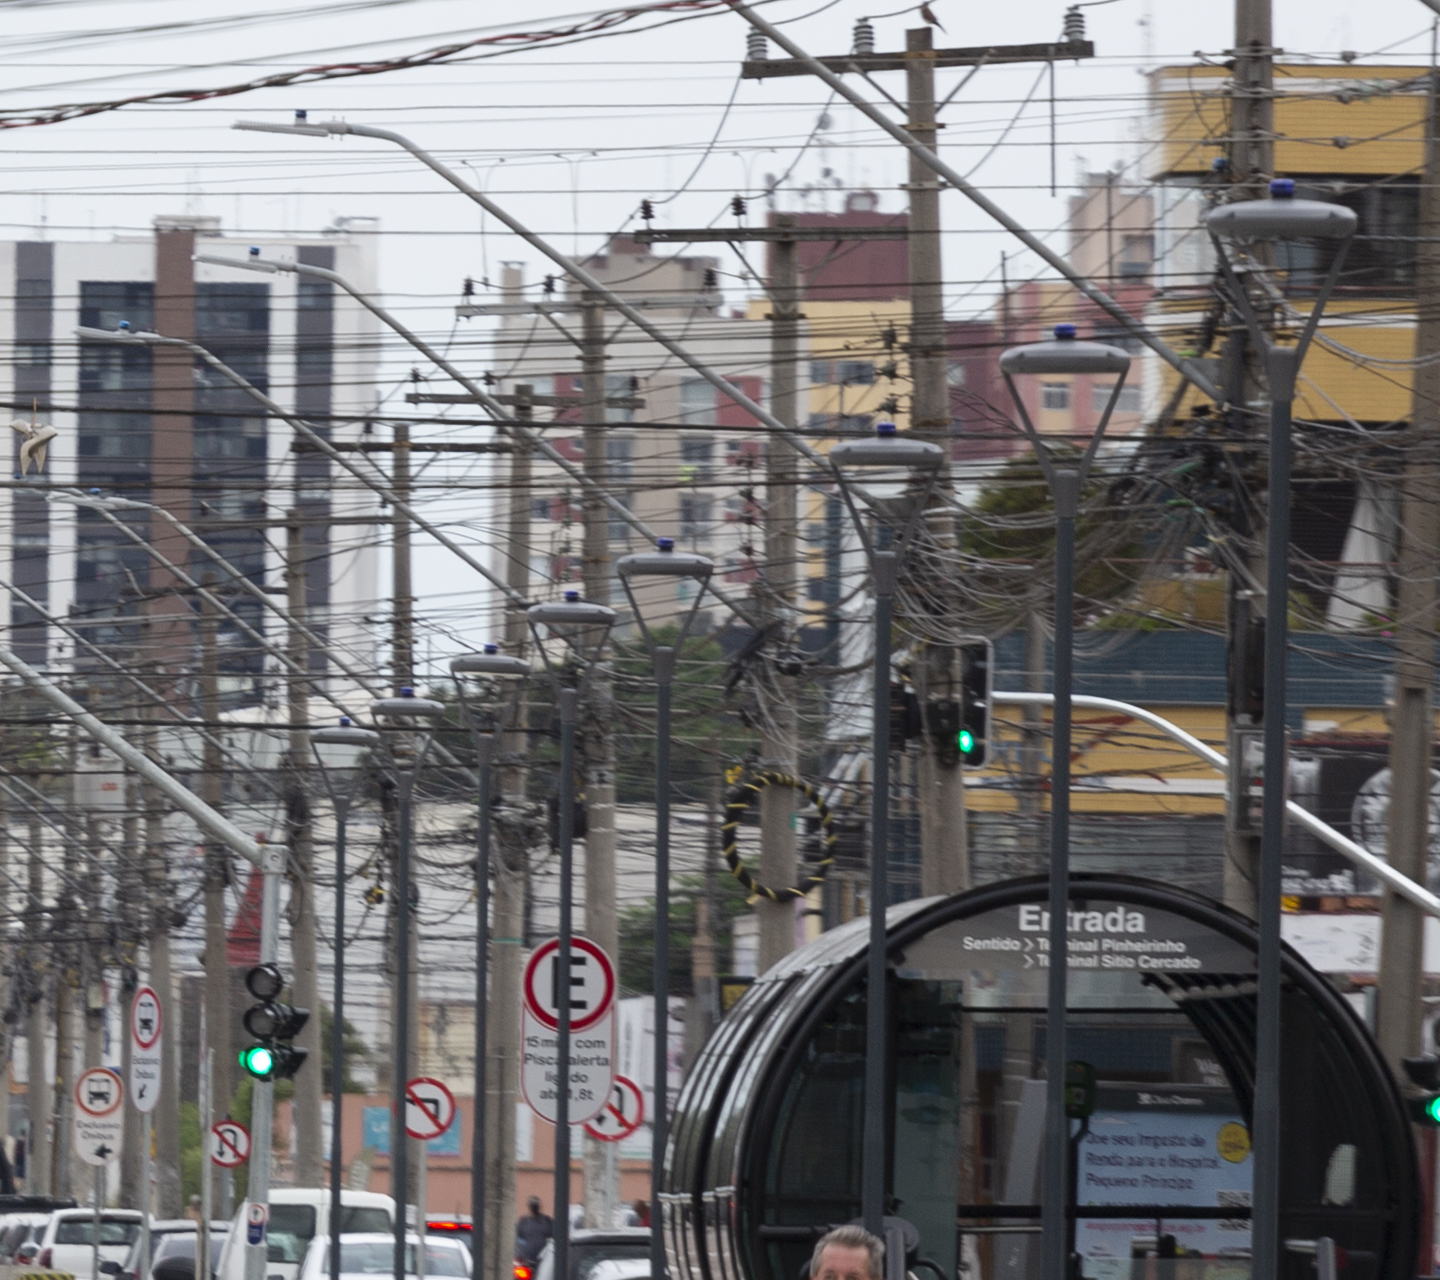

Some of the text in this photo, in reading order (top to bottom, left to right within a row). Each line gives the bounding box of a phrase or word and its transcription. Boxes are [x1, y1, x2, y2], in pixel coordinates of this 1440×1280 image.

[963, 937, 1021, 951] Sentido
[1101, 939, 1186, 953] Pinheirinho
[1138, 956, 1201, 969] Cercado
[552, 956, 587, 1010] E
[575, 1038, 606, 1049] com
